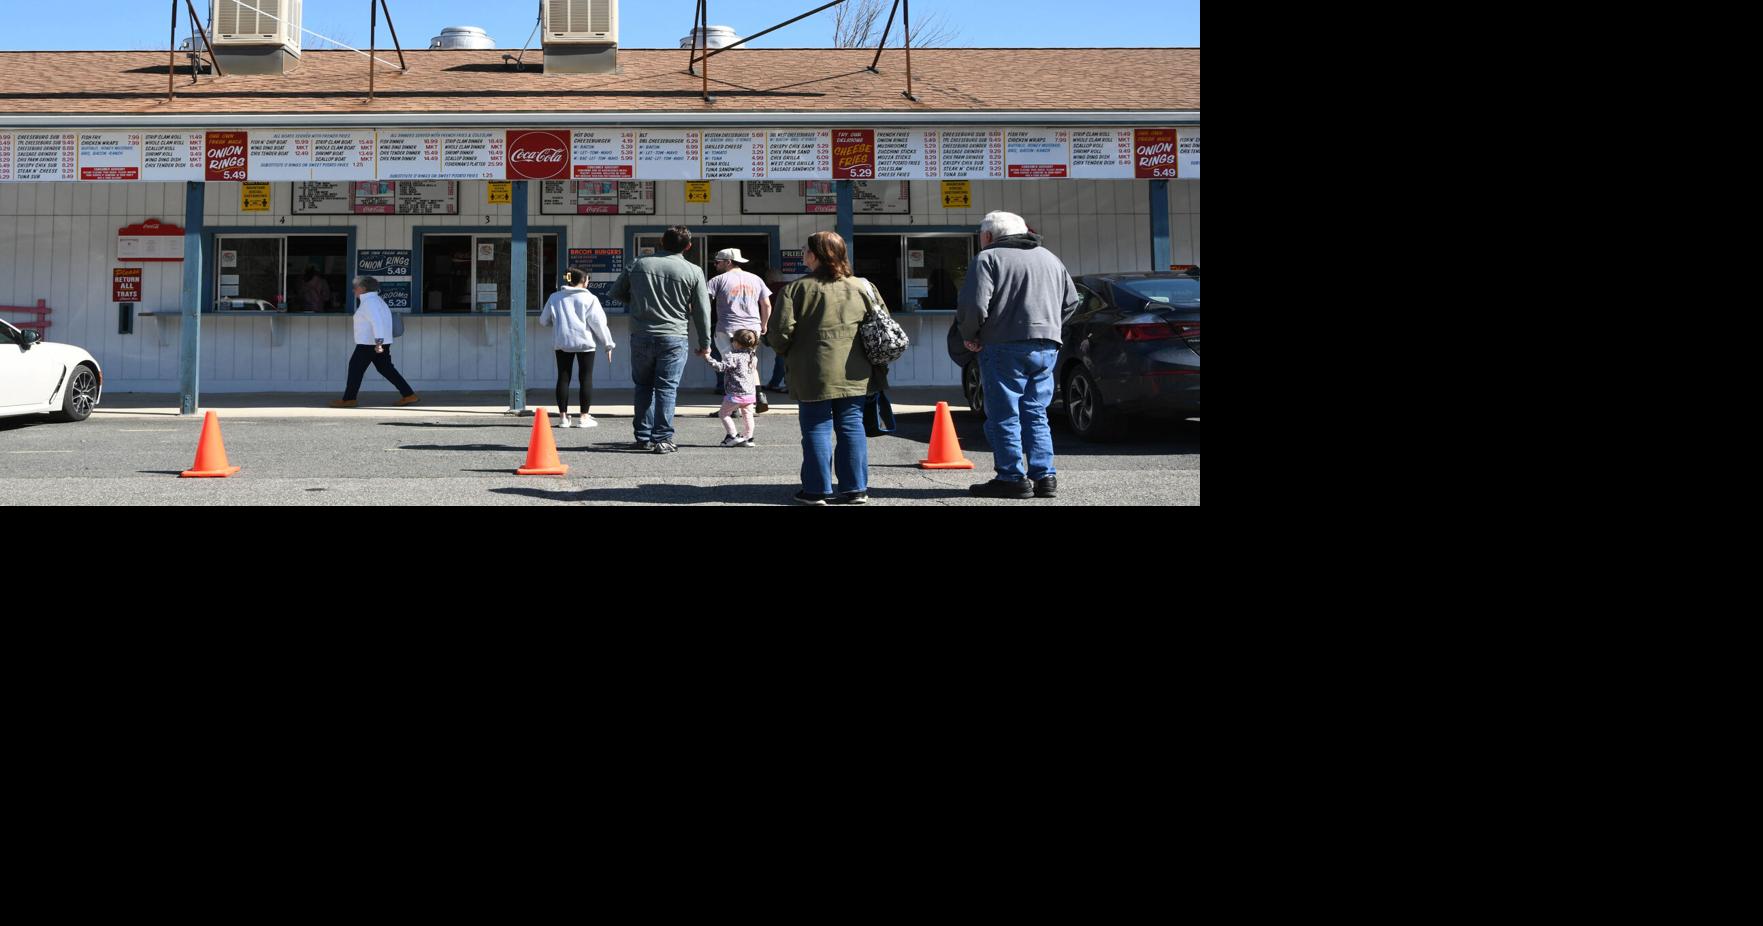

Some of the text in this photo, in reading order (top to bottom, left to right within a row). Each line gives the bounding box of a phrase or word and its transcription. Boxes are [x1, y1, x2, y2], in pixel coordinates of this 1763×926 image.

[207, 146, 243, 158] ONION
[511, 148, 566, 162] Coca-Cola
[834, 144, 872, 155] CHEESE
[1136, 143, 1173, 156] ONION
[210, 158, 245, 170] RINGS
[838, 154, 868, 167] FRIES
[1139, 154, 1175, 167] RINGS
[224, 171, 246, 179] 5.49
[850, 169, 872, 177] 5.29
[1153, 168, 1176, 177] 5.49
[485, 215, 490, 224] 3
[702, 215, 708, 224] 2
[359, 256, 409, 269] ONION RINGS
